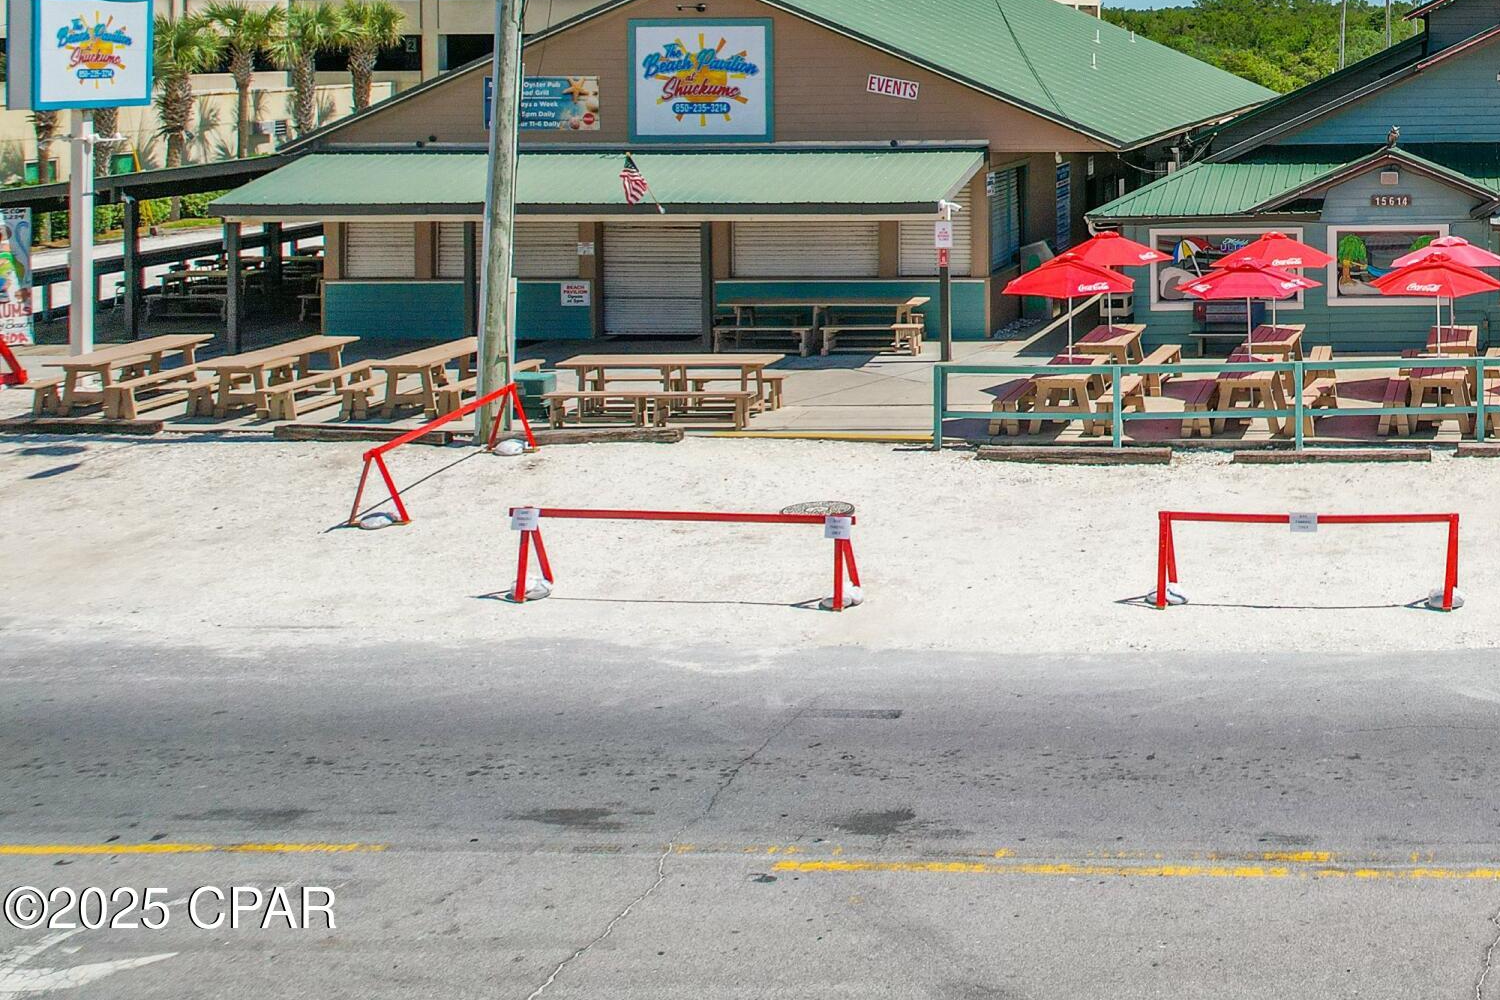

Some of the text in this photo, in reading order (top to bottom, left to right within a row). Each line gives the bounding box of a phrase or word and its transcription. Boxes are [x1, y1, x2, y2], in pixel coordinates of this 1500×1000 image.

[663, 43, 683, 58] The
[642, 48, 760, 79] Beach Pavilion
[685, 73, 696, 82] at
[869, 76, 917, 98] EVENTS
[675, 103, 728, 112] 850-235-3214
[1375, 196, 1408, 206] 15614
[1078, 282, 1110, 292] Coca-Cola
[0, 303, 32, 318] UMS
